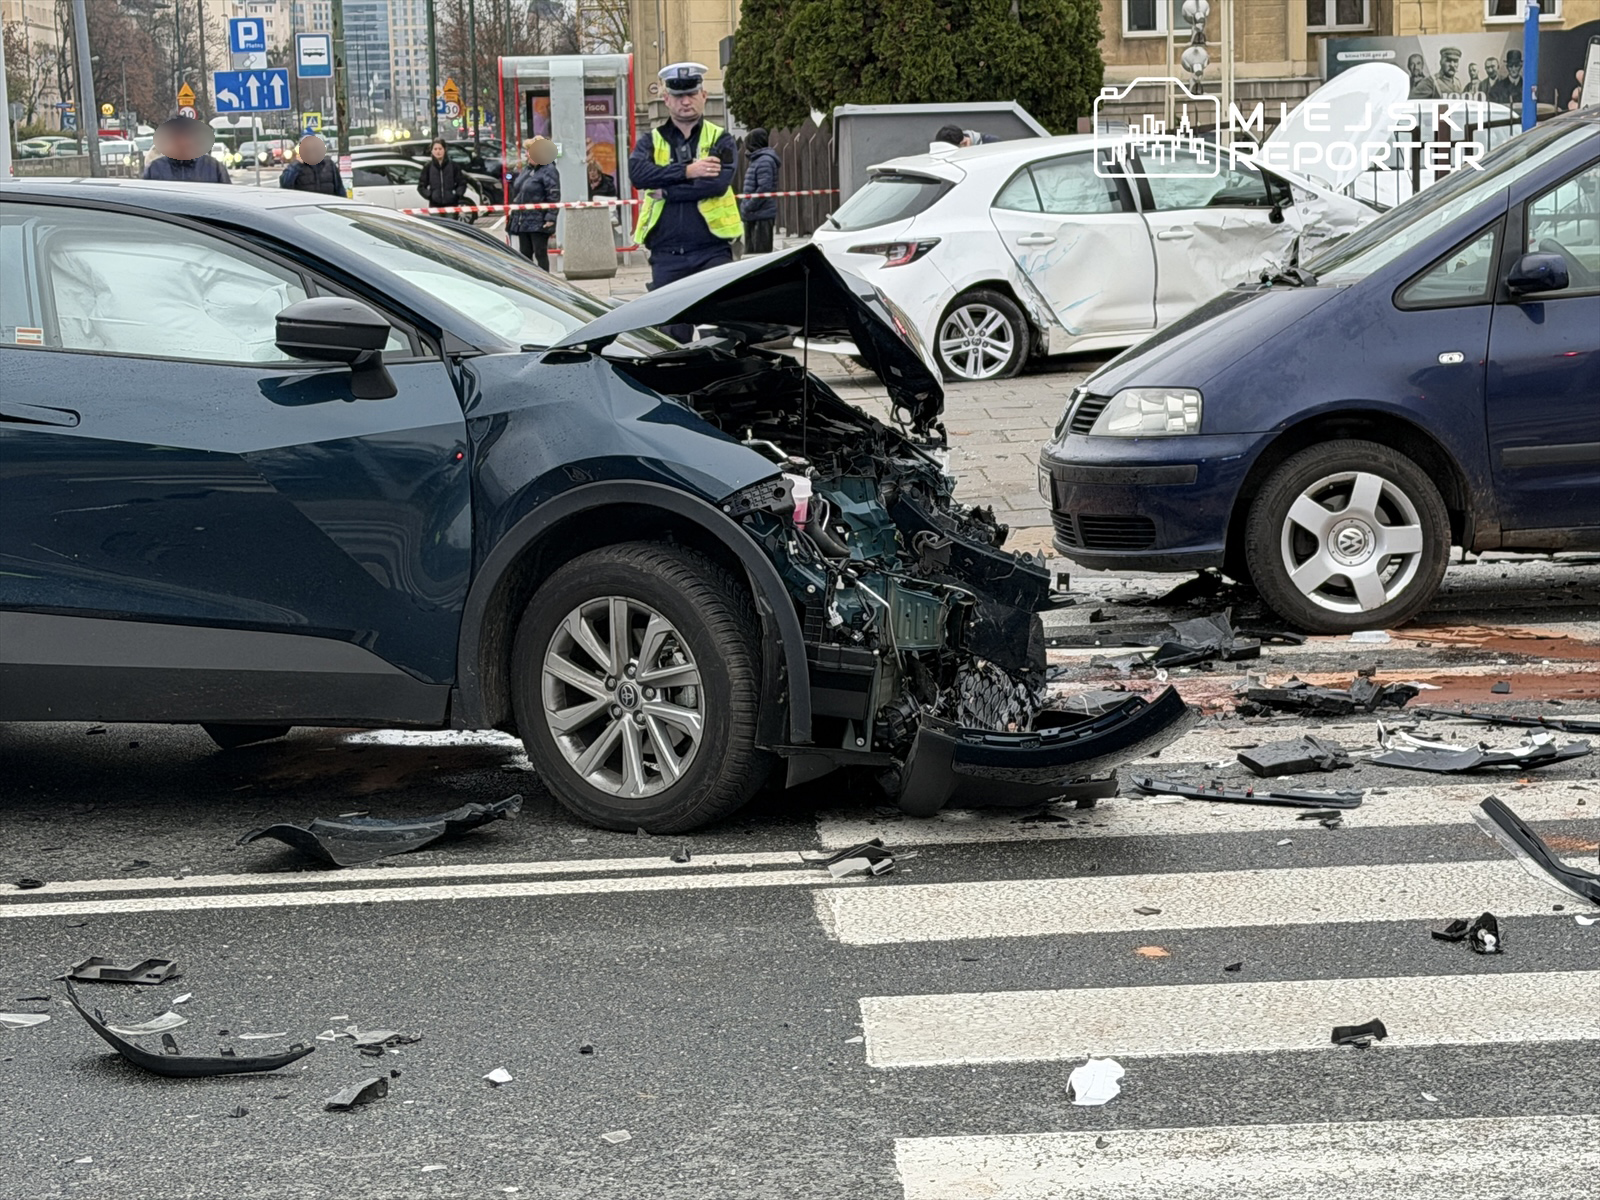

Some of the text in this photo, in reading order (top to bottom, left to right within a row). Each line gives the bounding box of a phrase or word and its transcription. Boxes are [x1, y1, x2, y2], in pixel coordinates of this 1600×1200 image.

[237, 21, 258, 49] P
[446, 105, 458, 114] 30
[584, 103, 607, 111] risco
